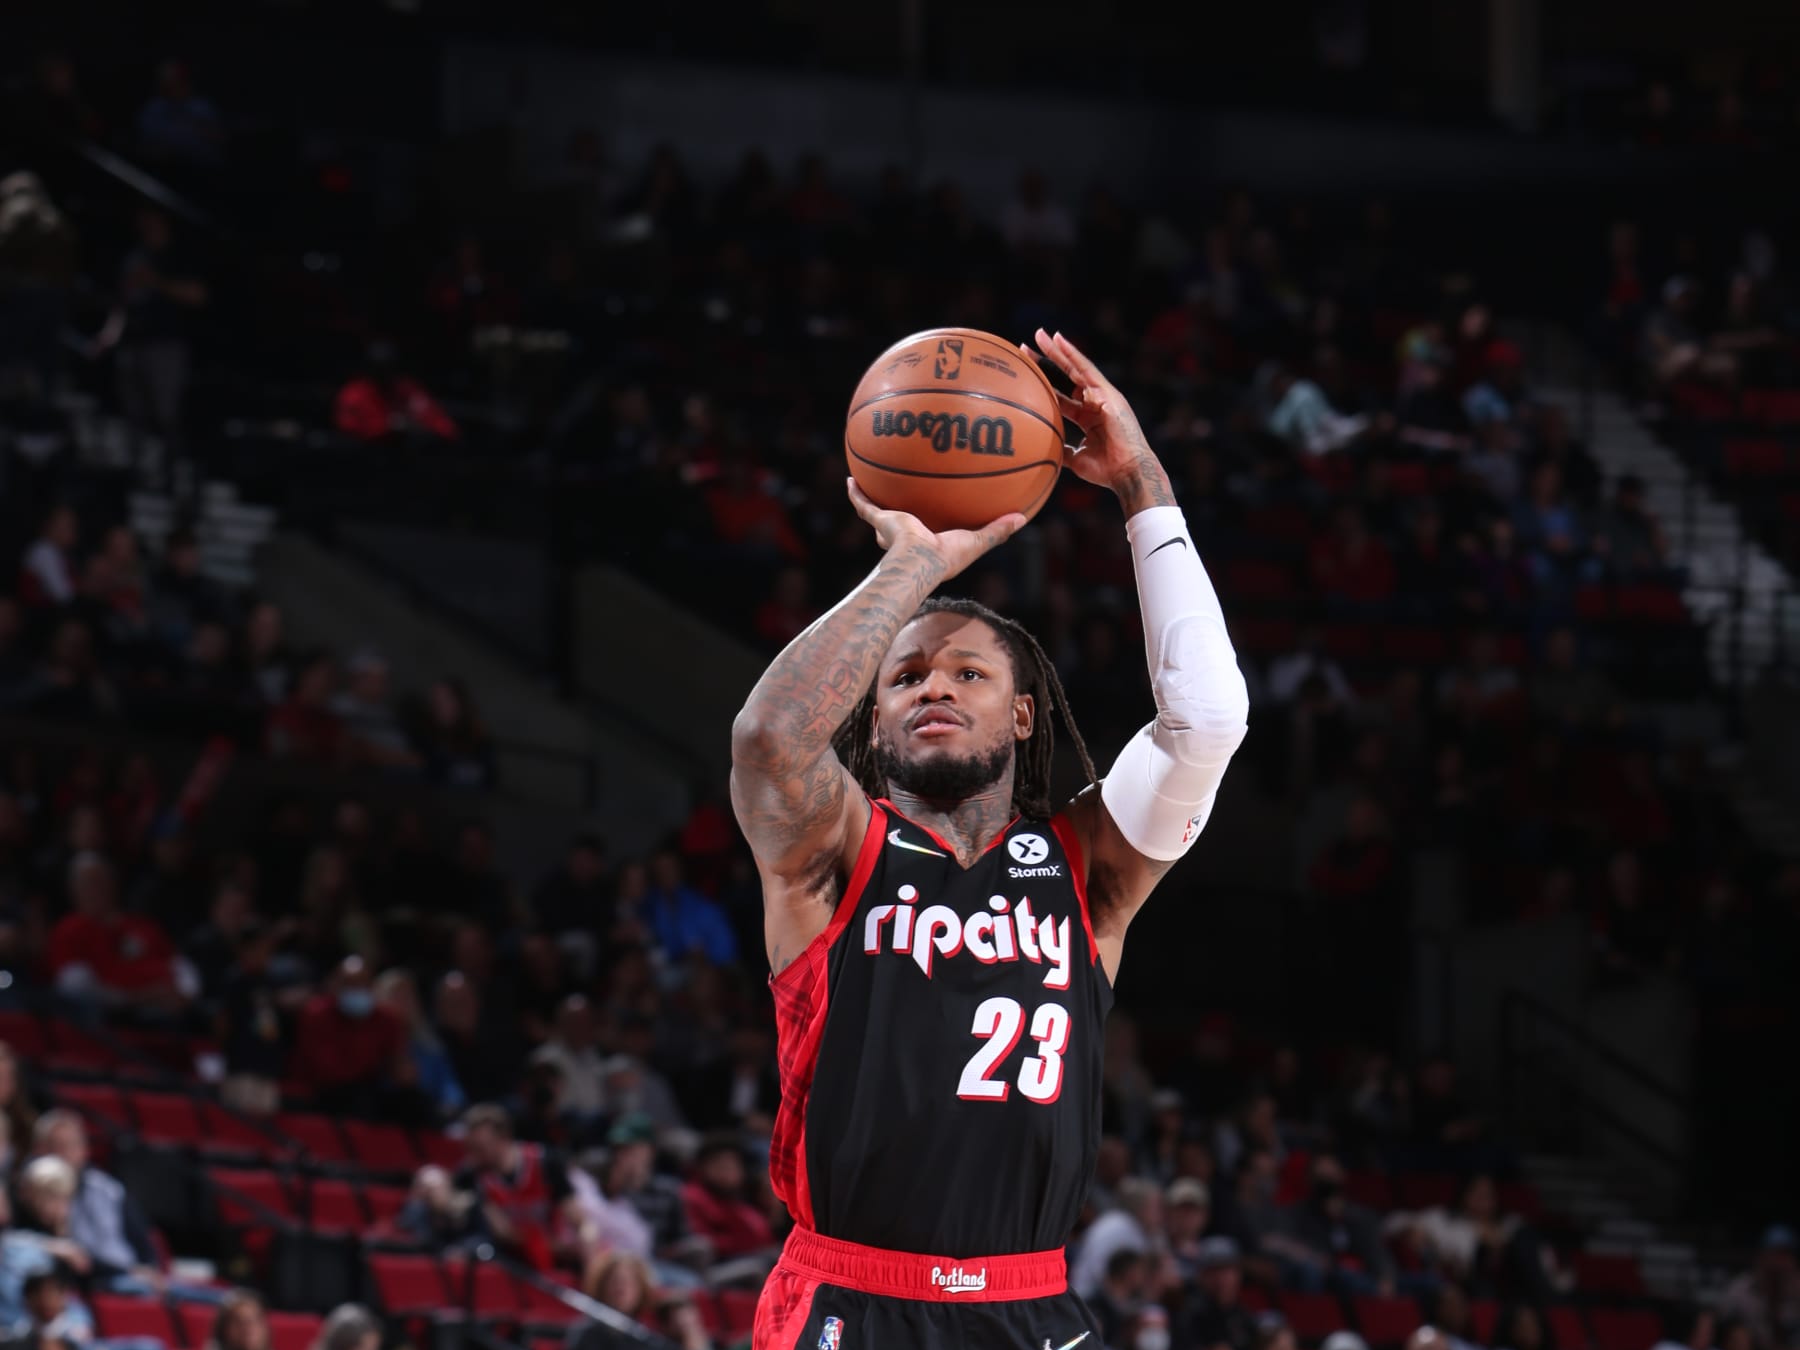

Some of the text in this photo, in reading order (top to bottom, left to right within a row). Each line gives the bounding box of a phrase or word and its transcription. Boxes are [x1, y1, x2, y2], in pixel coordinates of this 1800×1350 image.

[872, 409, 1015, 457] Wilson
[1008, 864, 1062, 879] StormX
[956, 996, 1072, 1105] 23
[931, 1265, 987, 1294] Portland
